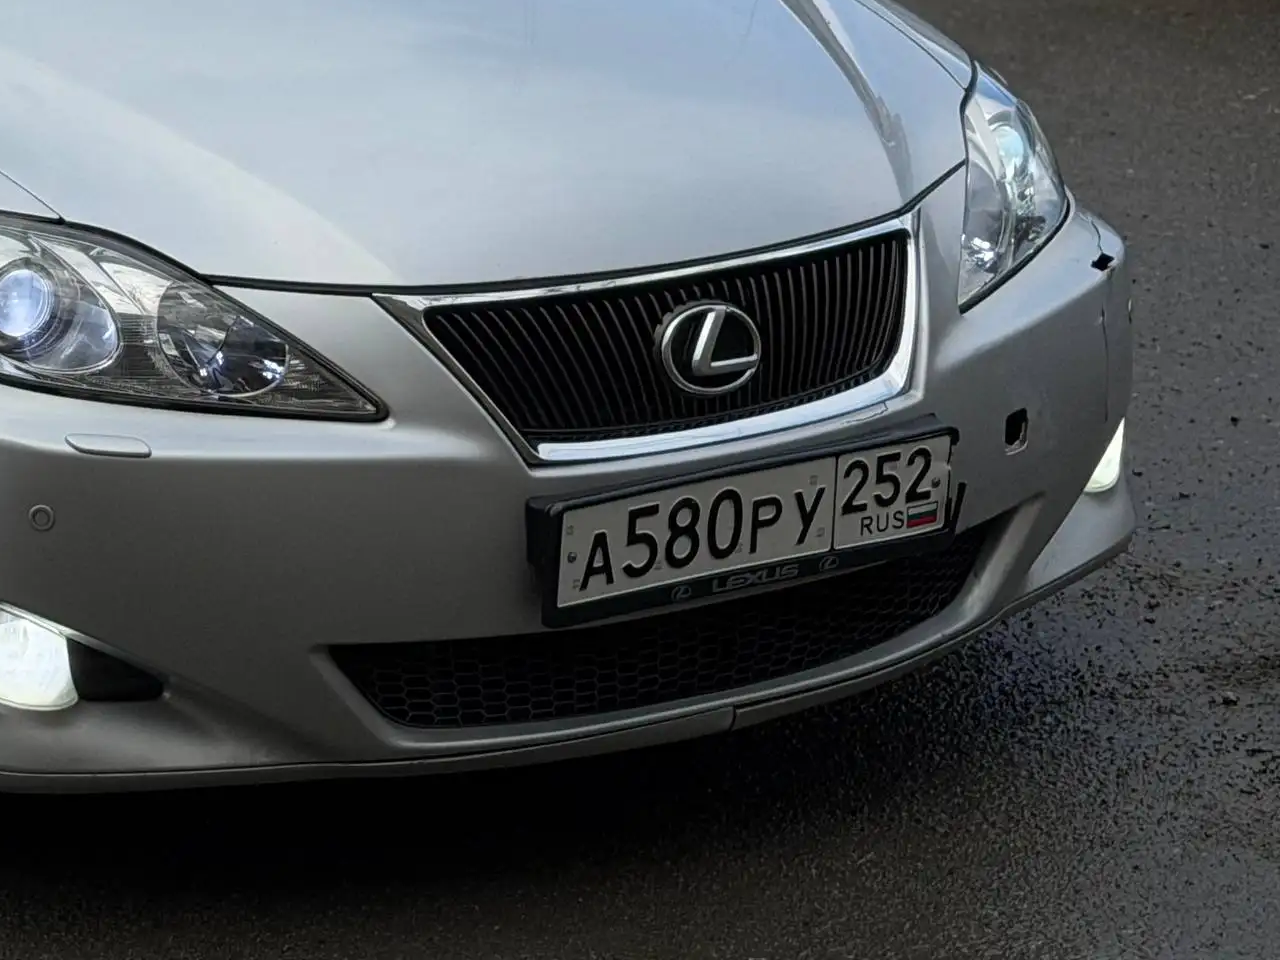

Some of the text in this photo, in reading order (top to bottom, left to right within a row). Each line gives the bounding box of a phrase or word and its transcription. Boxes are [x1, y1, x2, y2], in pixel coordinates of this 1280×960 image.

[579, 447, 932, 591] А580РУ 252
[860, 510, 905, 536] RUS
[712, 564, 800, 593] LEXUS
